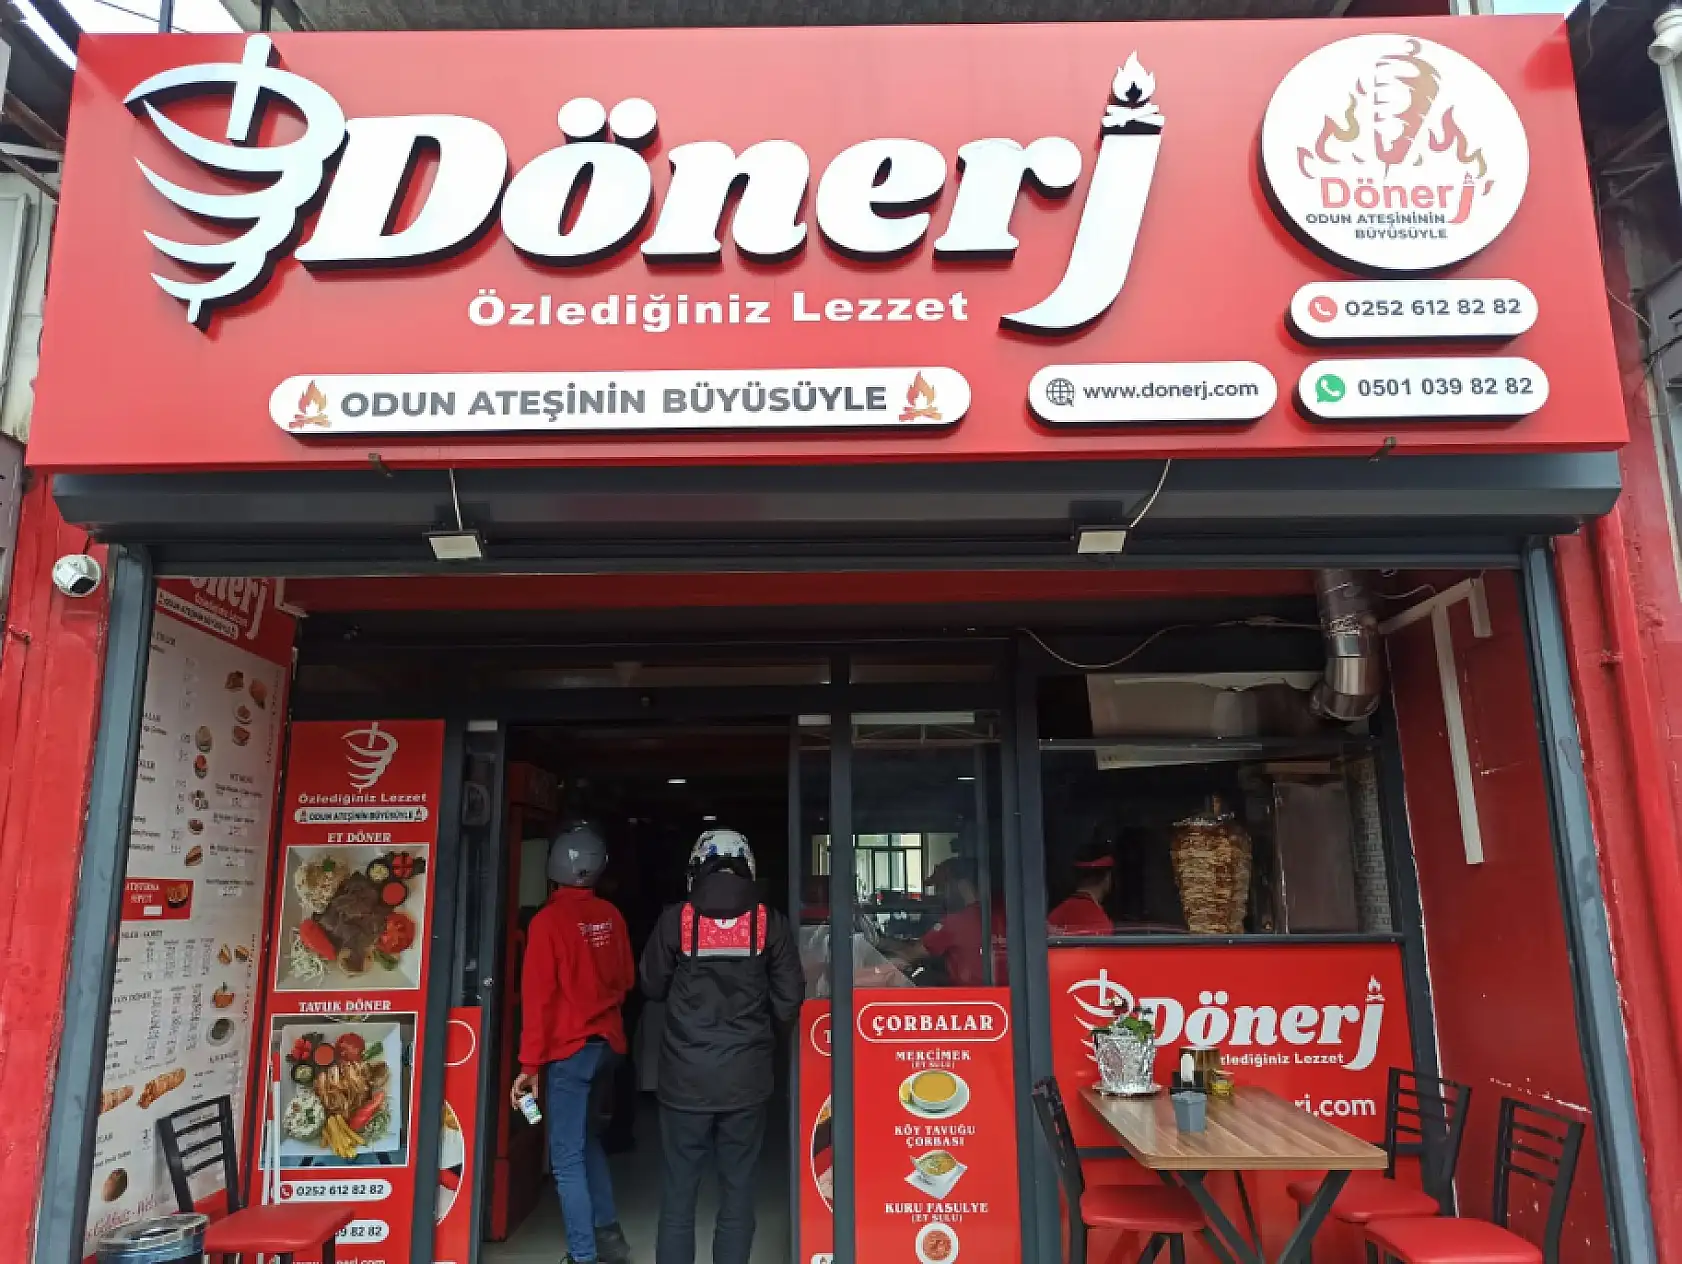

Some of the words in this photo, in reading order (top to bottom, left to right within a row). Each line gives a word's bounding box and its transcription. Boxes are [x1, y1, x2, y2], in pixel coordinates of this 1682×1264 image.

[294, 52, 1164, 331] Dönerj
[1305, 213, 1352, 224] ODUN
[1355, 226, 1448, 239] BÜYÜSÜYLE
[468, 288, 772, 333] Özlediğiniz
[792, 290, 969, 322] Lezzet
[1344, 300, 1404, 316] 0252
[1411, 300, 1450, 315] 612
[1457, 299, 1486, 314] 82
[1493, 298, 1521, 314] 82
[1083, 381, 1259, 401] www.donerj.com
[1357, 379, 1412, 396] 0501
[1421, 379, 1463, 395] 039
[1471, 378, 1501, 394] 82
[1505, 377, 1533, 394] 82
[341, 391, 456, 418] ODUN
[468, 382, 645, 422] ATEŞİNİN
[663, 380, 887, 416] BÜYÜSÜYLE
[298, 791, 377, 805] Özlediğiniz
[381, 792, 427, 803] Lezzet
[327, 832, 343, 842] ET
[347, 828, 391, 842] DÖNER
[298, 1001, 341, 1012] TAVUK
[345, 998, 392, 1011] DÖNER
[872, 1014, 994, 1036] ÇORBALAR
[1138, 974, 1386, 1070] Dönerj
[895, 1048, 972, 1061] MERCİMEK
[1220, 1052, 1290, 1068] zlediğiniz
[1294, 1052, 1344, 1064] Lezzet
[894, 1124, 921, 1135] KÖY
[925, 1124, 976, 1135] TAVUĞU
[906, 1137, 965, 1148] ÇORBASI
[296, 1186, 326, 1196] 0252
[329, 1185, 349, 1195] 612
[352, 1184, 365, 1194] 82
[369, 1184, 384, 1194] 82
[885, 1202, 923, 1213] KURU
[926, 1202, 989, 1213] FASULYE
[350, 1227, 365, 1236] 82
[368, 1227, 382, 1236] 82
